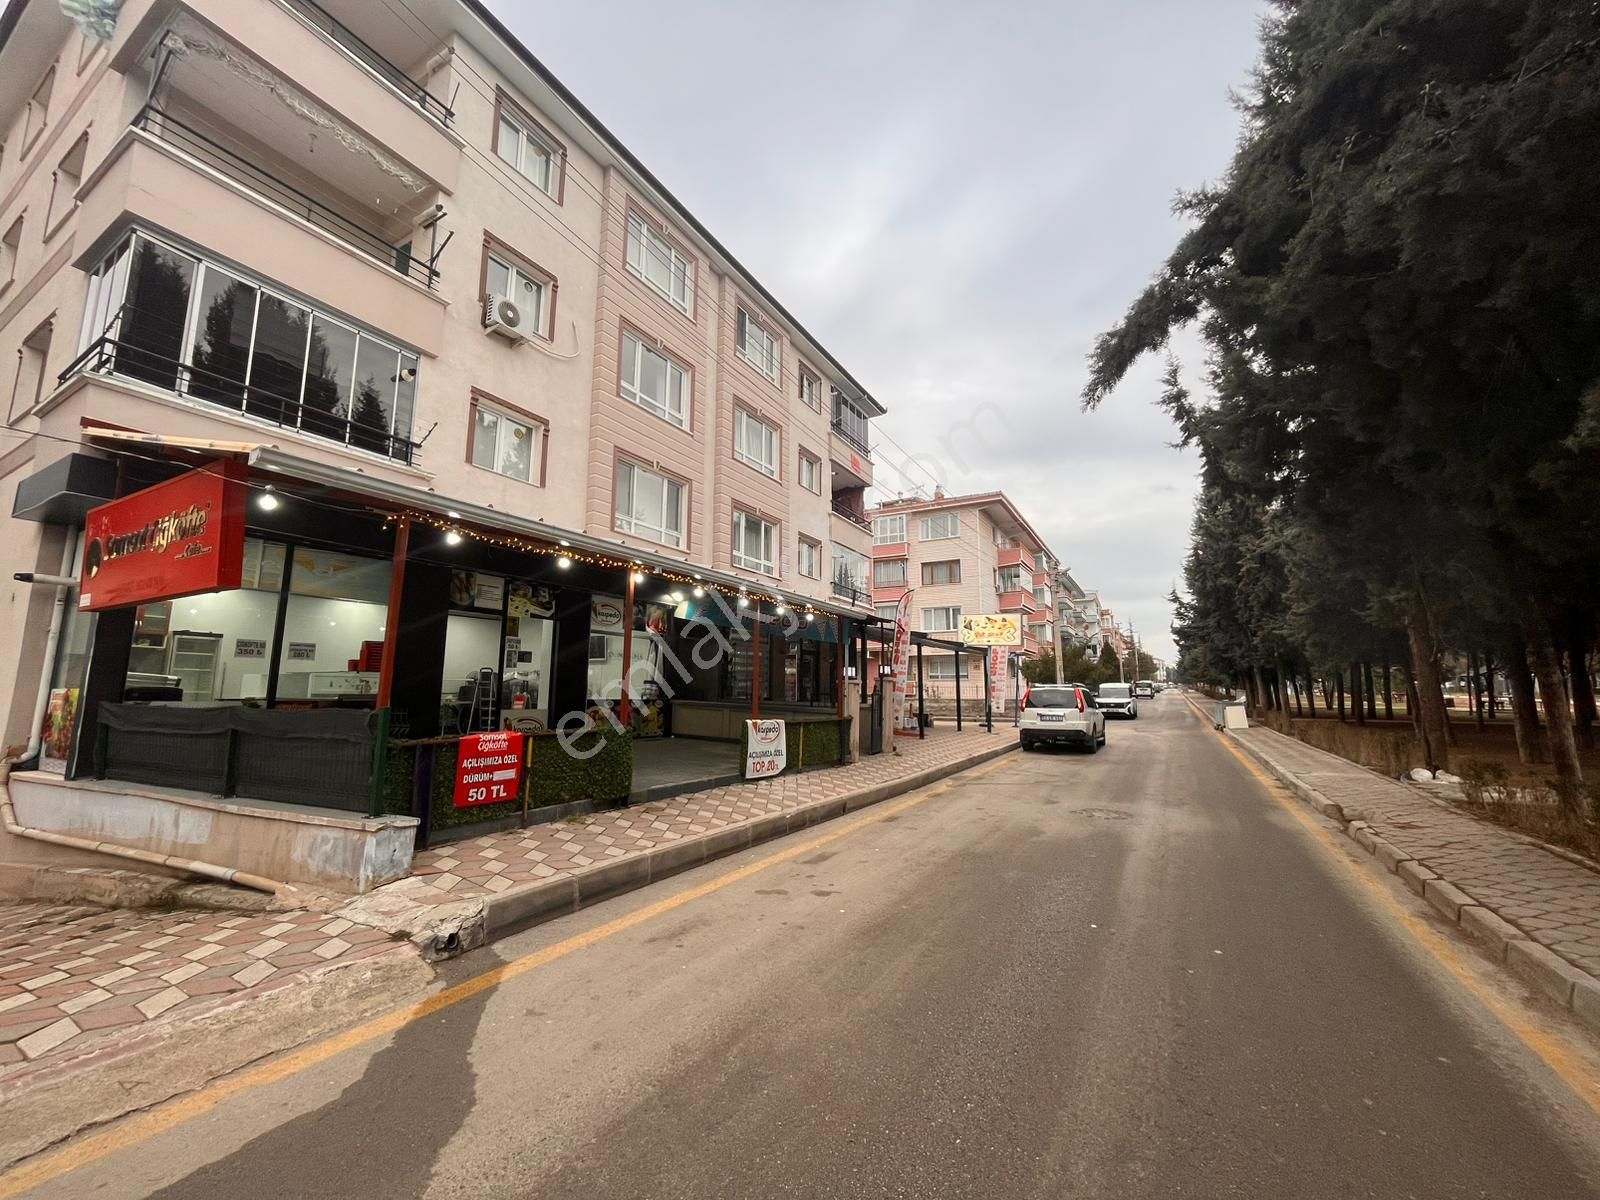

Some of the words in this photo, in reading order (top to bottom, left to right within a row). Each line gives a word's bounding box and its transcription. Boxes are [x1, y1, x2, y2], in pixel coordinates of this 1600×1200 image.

[462, 756, 503, 769] AÇILIŞIMIZA
[503, 754, 518, 764] ÖZEL
[752, 761, 766, 773] TOP
[467, 787, 487, 802] 50
[490, 784, 507, 798] TL
